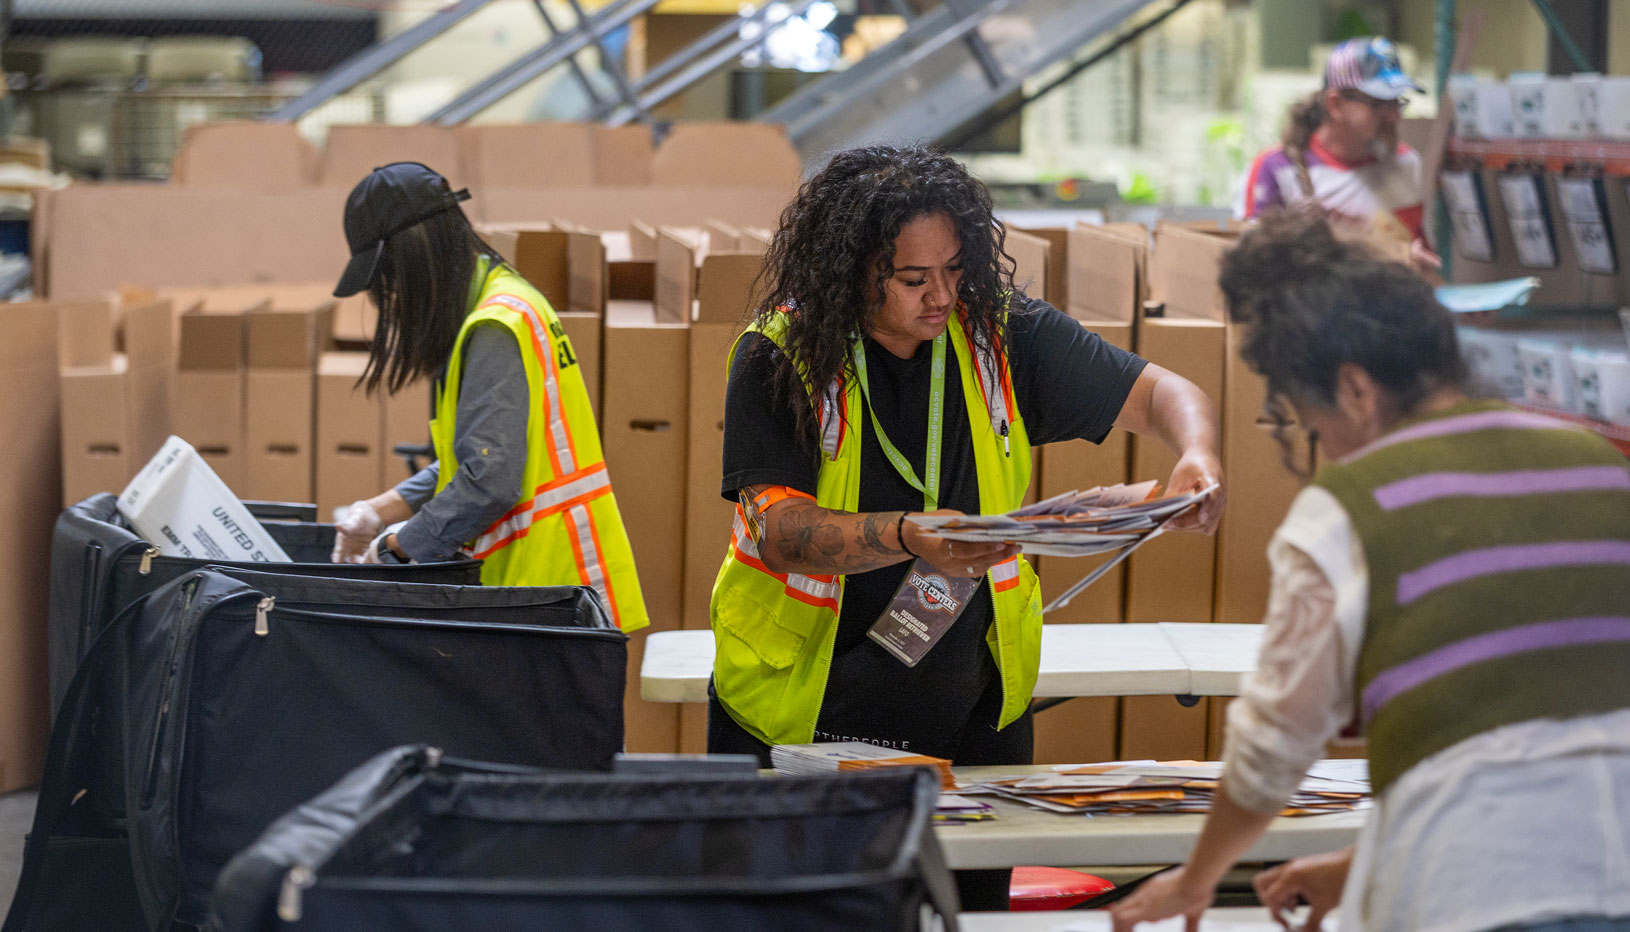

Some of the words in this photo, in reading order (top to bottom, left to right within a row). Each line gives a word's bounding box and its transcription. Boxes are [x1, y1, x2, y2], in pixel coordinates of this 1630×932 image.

[161, 526, 181, 546] EMM
[181, 545, 196, 559] TR
[213, 507, 254, 550] UNITED
[911, 574, 928, 592] VOTE
[927, 587, 957, 610] CENTERS
[889, 610, 908, 626] BALLOT
[905, 621, 931, 642] RETRIEVER
[900, 609, 929, 632] DESIGNATED
